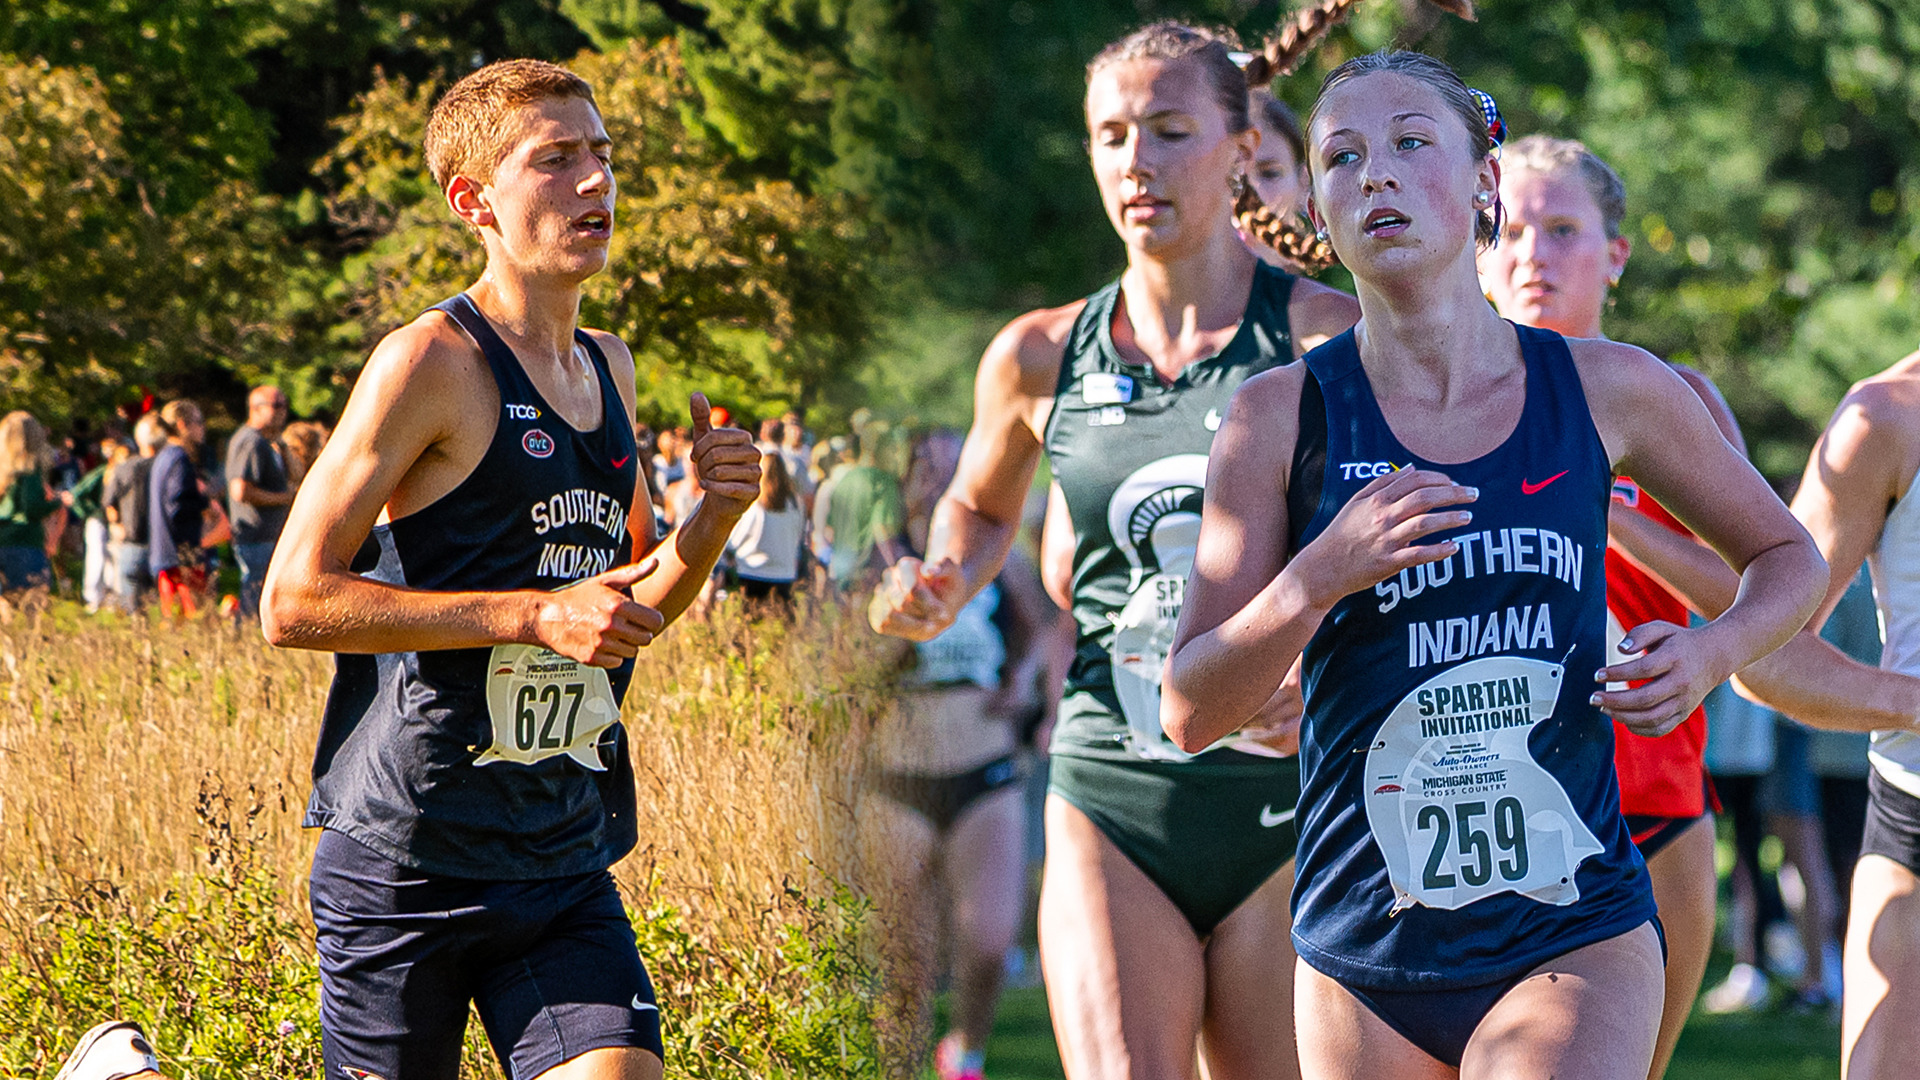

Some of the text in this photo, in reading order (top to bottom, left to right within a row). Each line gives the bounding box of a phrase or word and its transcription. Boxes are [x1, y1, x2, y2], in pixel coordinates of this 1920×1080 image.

[506, 404, 537, 419] TCG
[1340, 462, 1390, 480] TCG
[531, 489, 629, 545] SOUTHERN
[1375, 528, 1583, 614] SOUTHERN
[1408, 603, 1553, 668] INDIANA
[1417, 676, 1531, 716] SPARTAN
[515, 683, 585, 751] 627
[1421, 707, 1535, 738] INVITATIONAL
[1433, 753, 1500, 767] Auto-Owners
[1446, 763, 1488, 772] INSURANCE
[1422, 770, 1507, 789] MICHIGAN STATE
[1424, 783, 1507, 797] CROSS COUNTRY
[1417, 797, 1529, 890] 259
